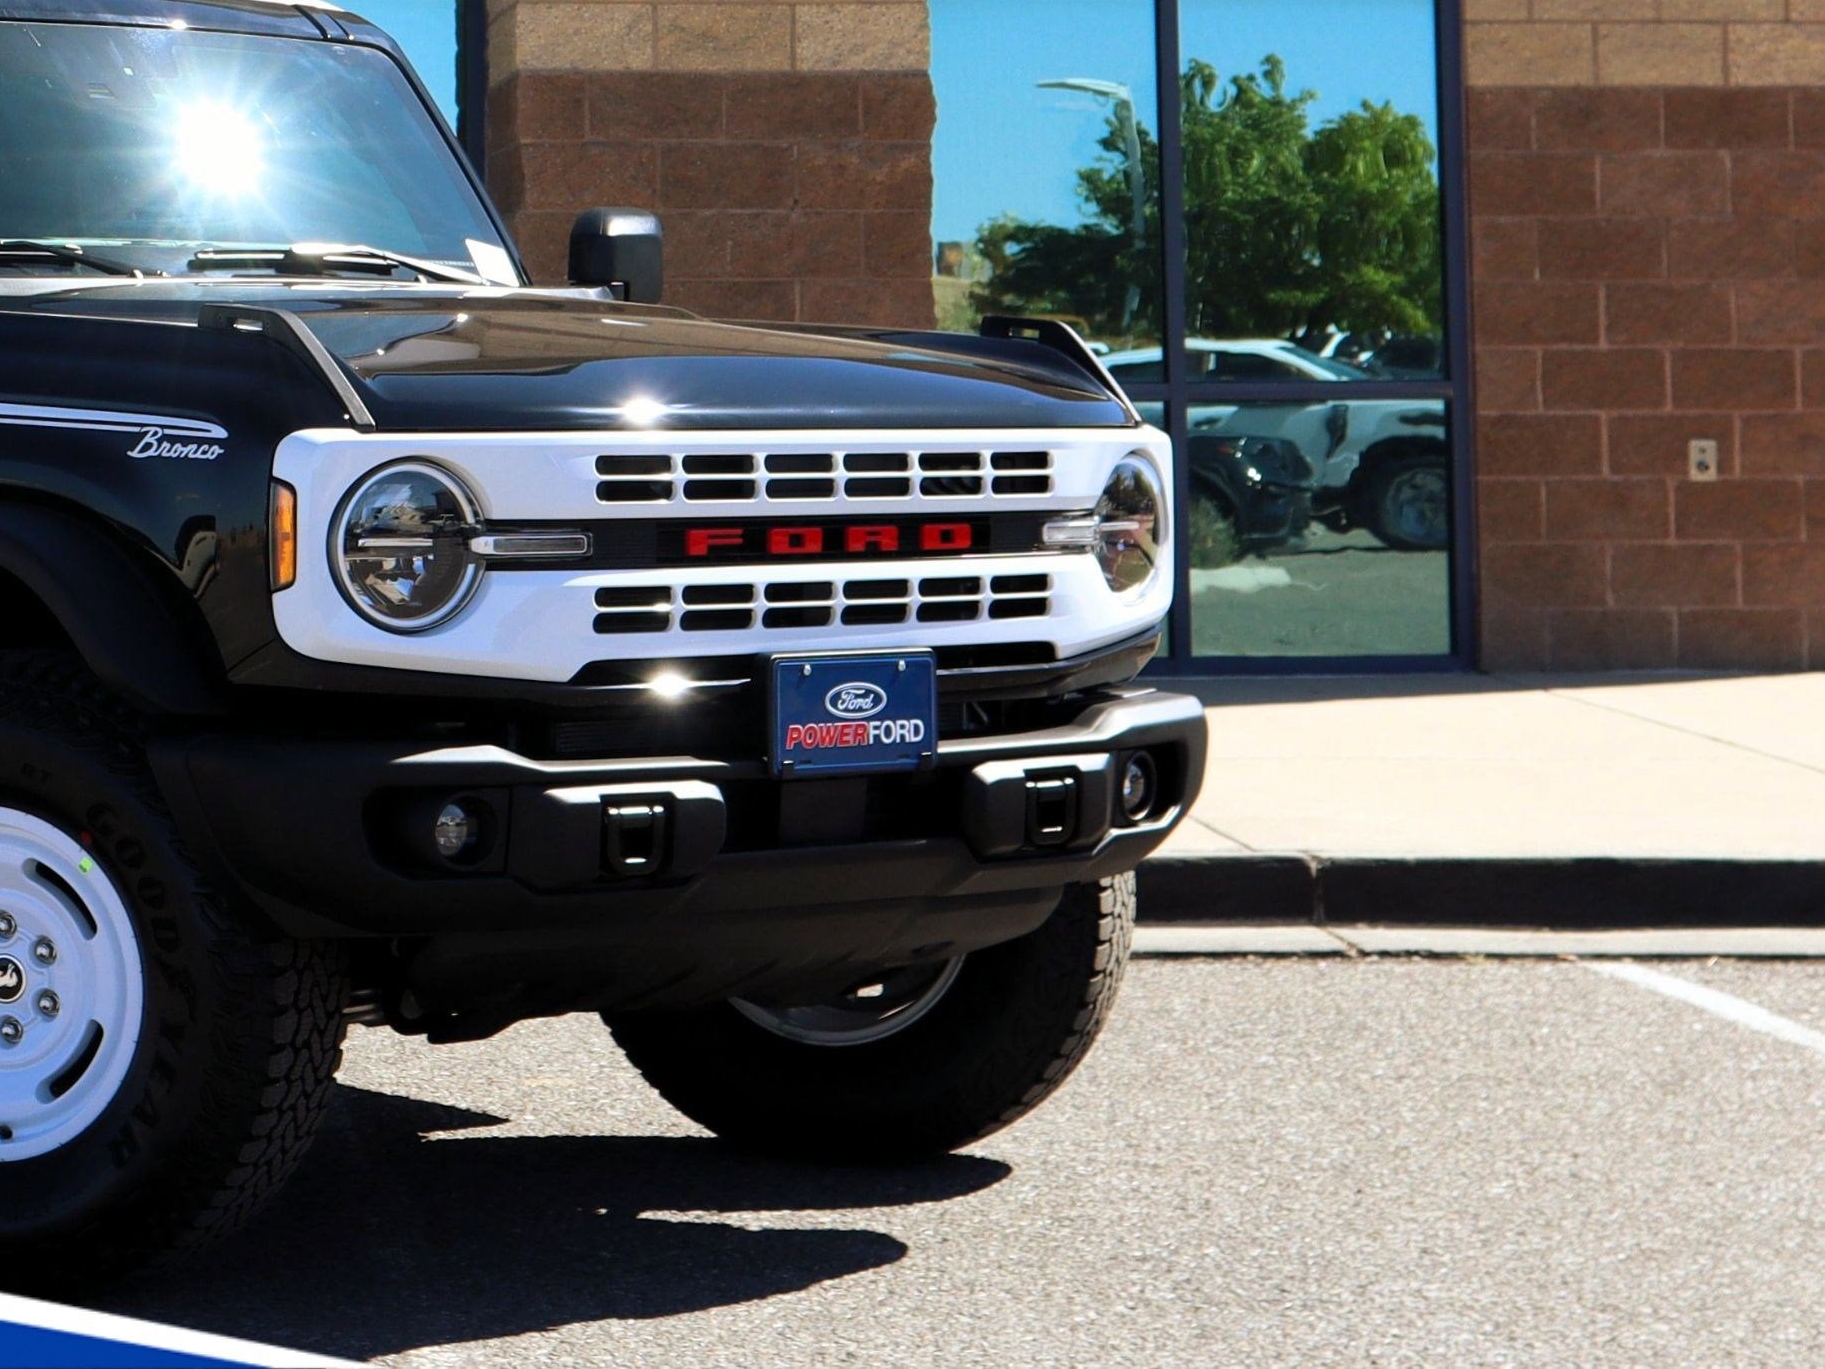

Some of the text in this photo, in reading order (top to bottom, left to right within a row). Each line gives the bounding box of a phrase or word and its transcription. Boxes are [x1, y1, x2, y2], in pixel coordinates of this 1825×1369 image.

[126, 426, 225, 460] Bronco
[685, 523, 972, 557] FORD
[837, 689, 875, 711] Ford
